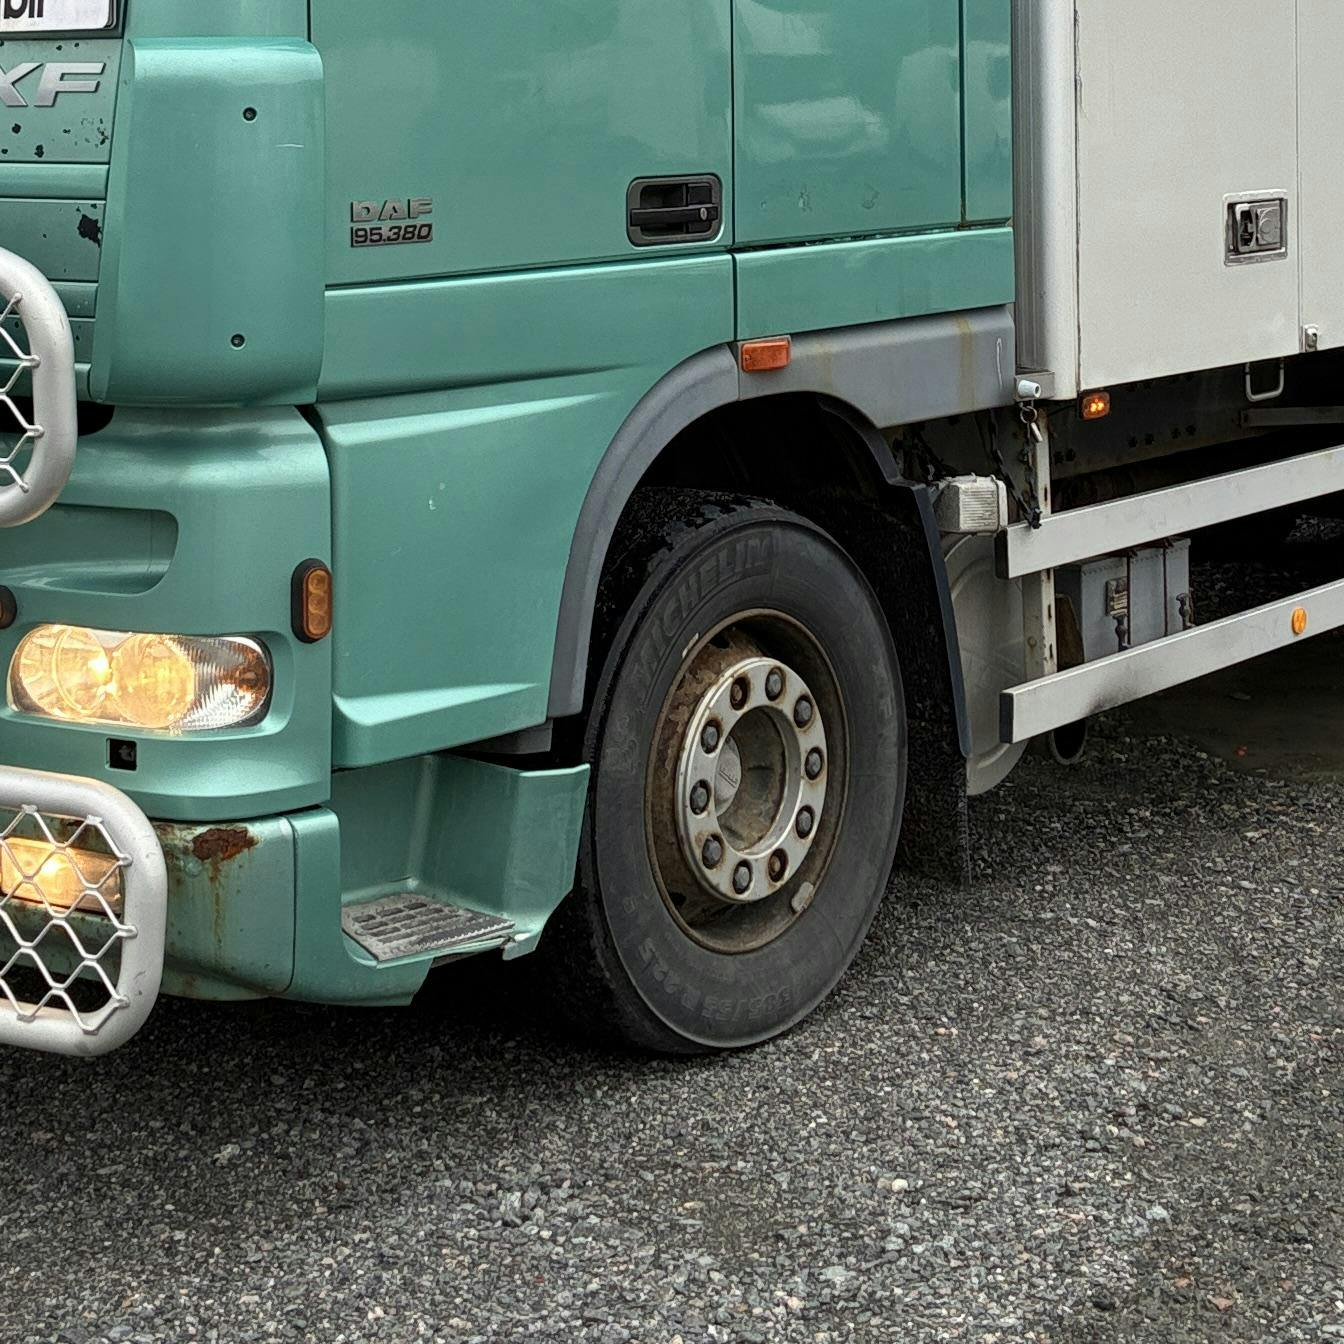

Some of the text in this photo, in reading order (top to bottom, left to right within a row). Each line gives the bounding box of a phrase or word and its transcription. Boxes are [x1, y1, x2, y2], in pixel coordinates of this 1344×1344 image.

[351, 197, 432, 222] DAF
[355, 224, 432, 244] 95.380
[639, 535, 771, 676] MICHELIN
